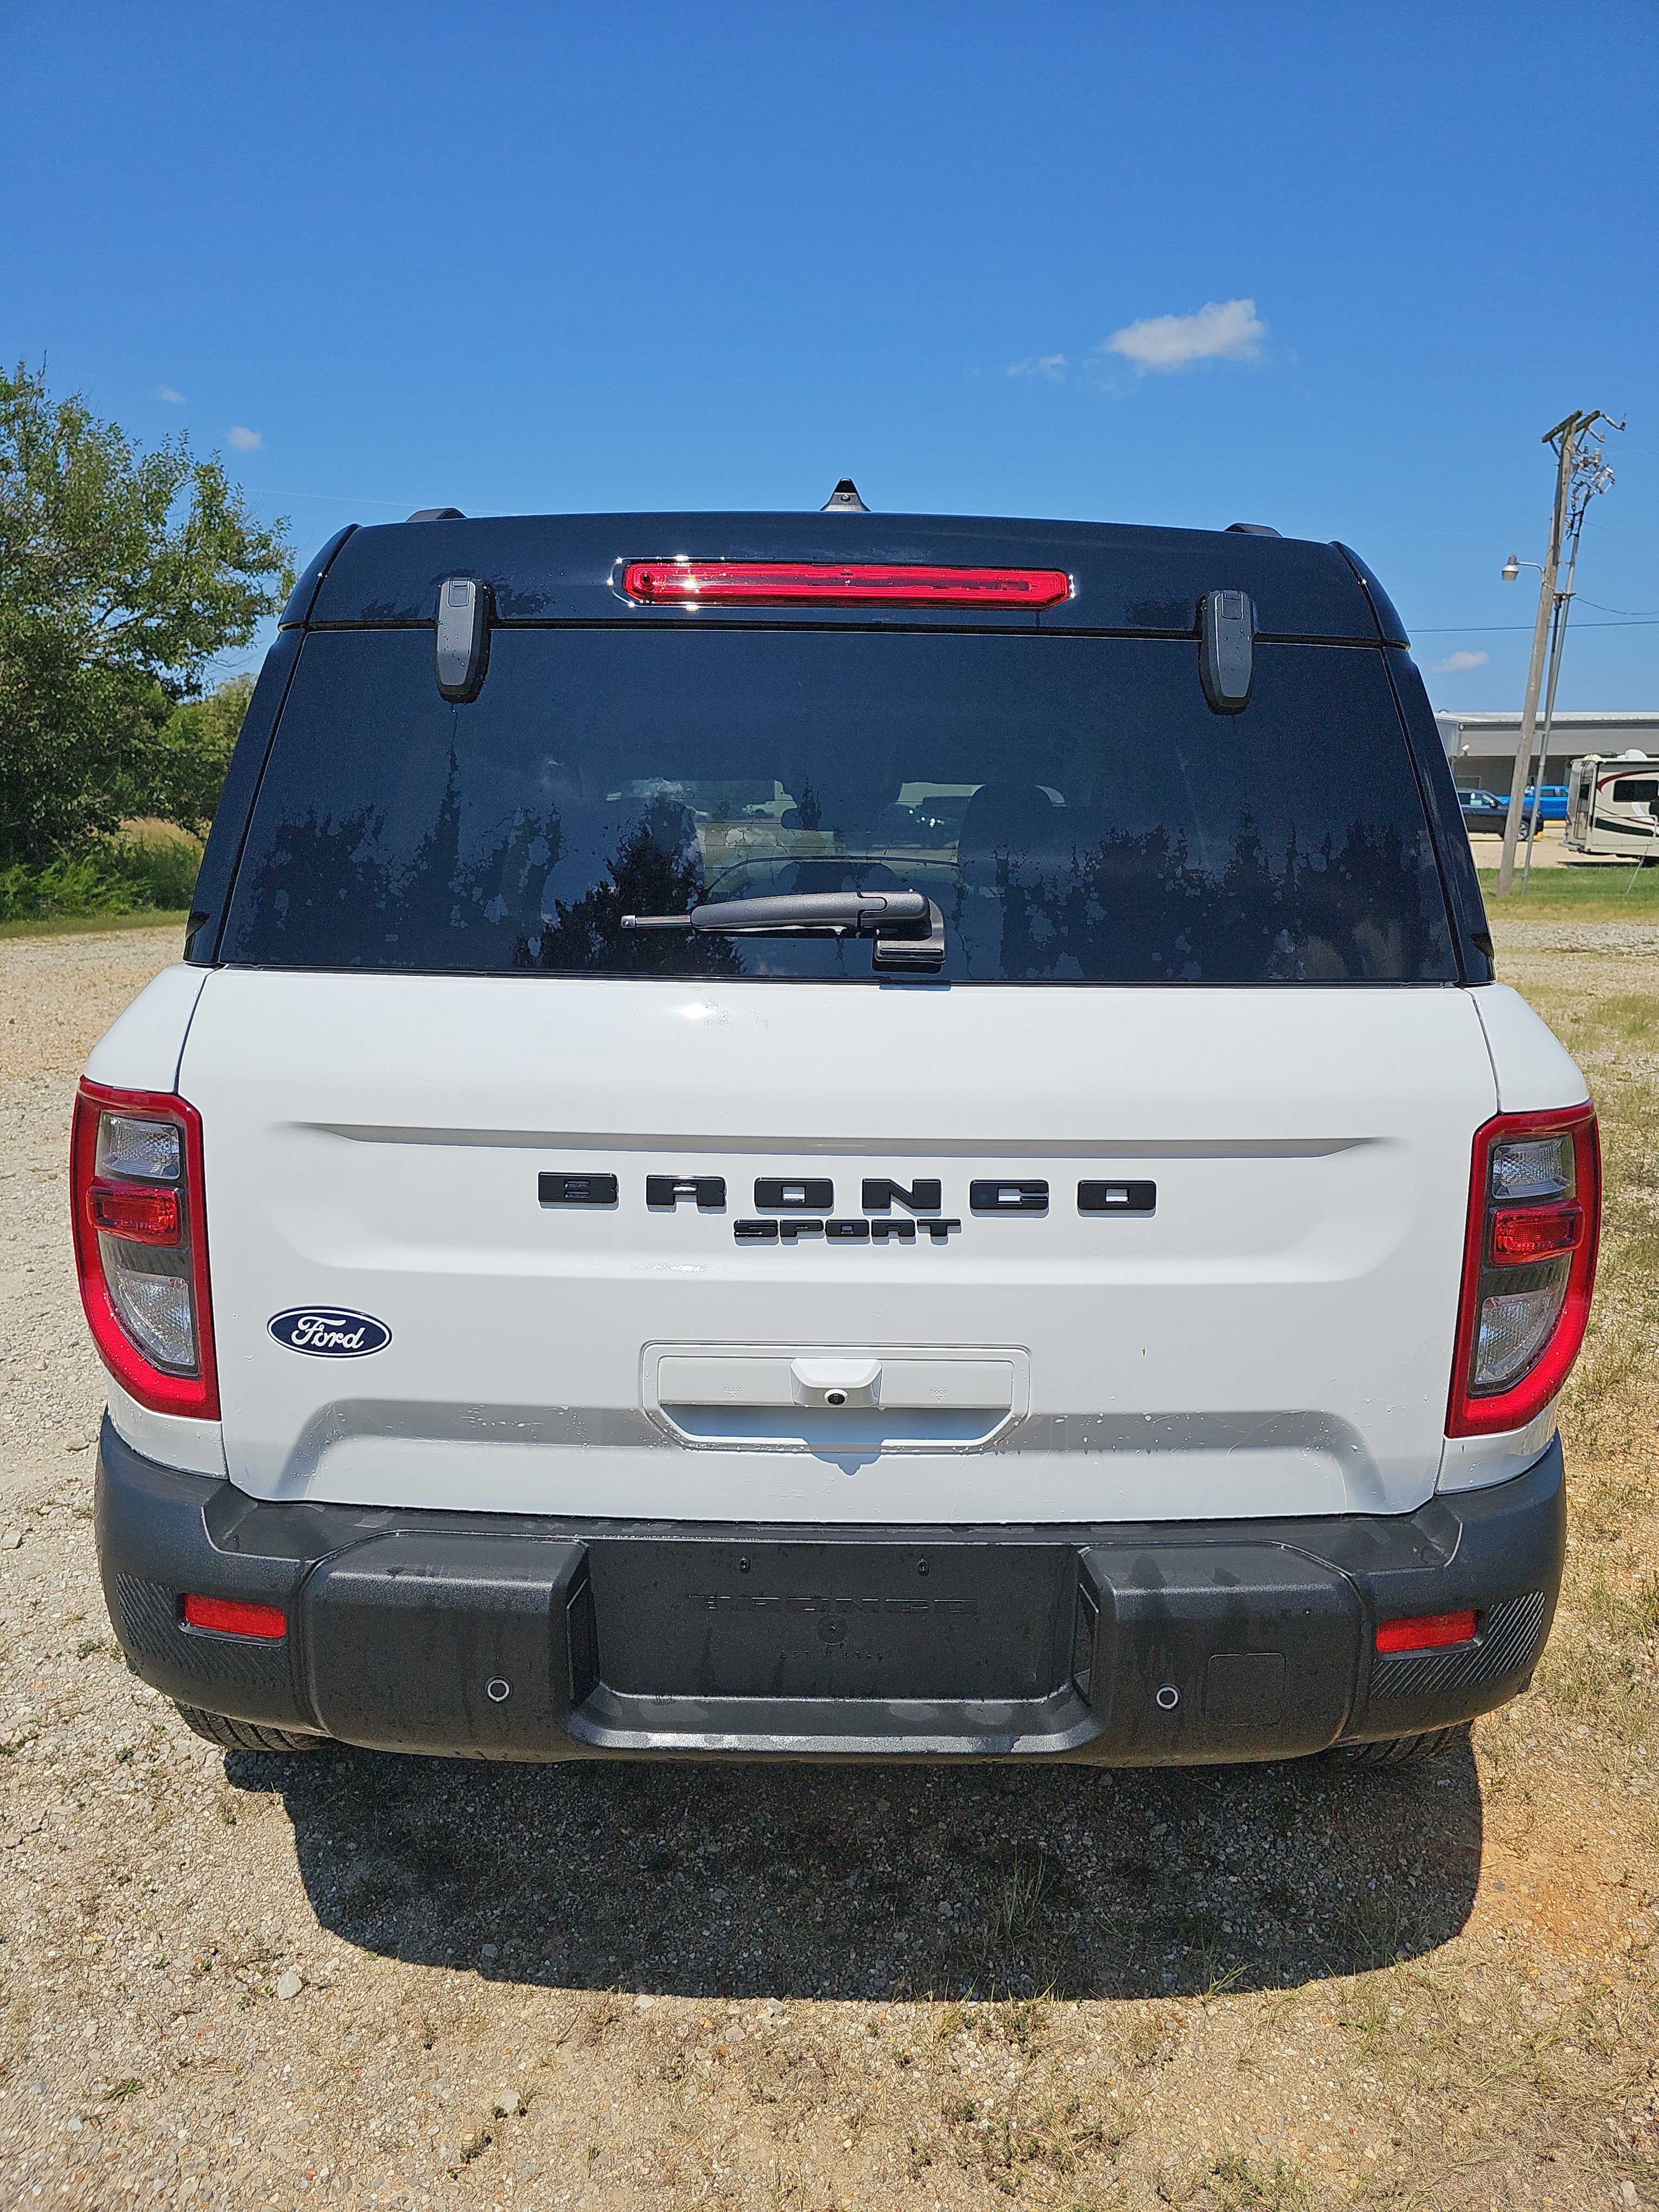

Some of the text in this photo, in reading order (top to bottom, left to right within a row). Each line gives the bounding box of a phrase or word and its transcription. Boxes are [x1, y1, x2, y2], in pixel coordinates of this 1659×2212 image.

[538, 1172, 1156, 1212] BRONCO
[734, 1218, 961, 1237] SPORT
[291, 1316, 365, 1348] Ford
